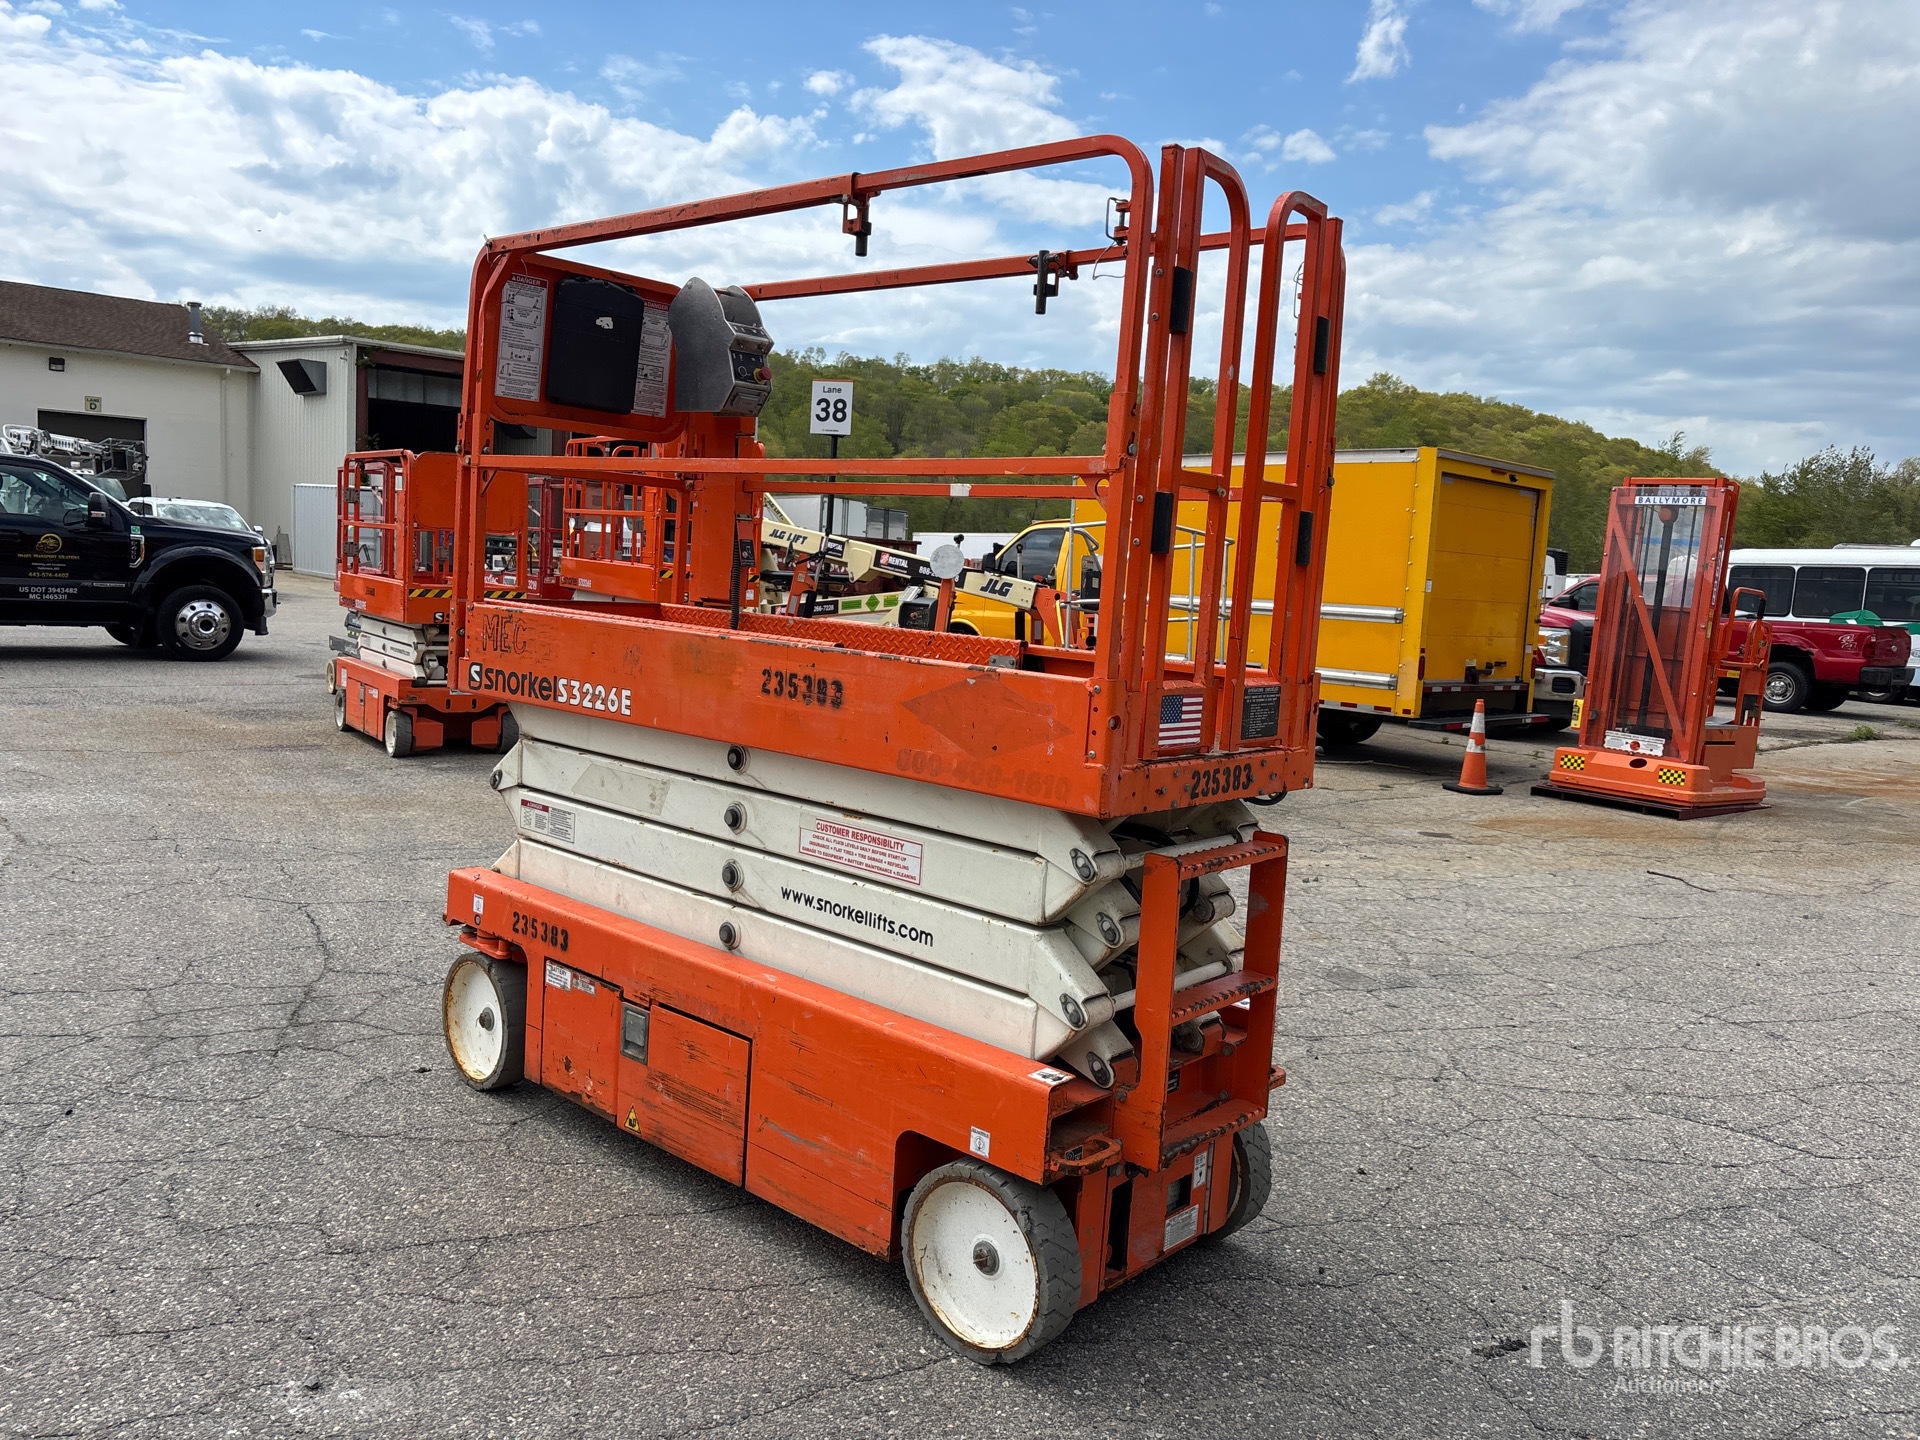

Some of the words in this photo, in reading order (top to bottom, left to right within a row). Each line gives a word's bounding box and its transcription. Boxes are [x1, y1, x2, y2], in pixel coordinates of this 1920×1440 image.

[815, 398, 847, 422] 38
[1638, 496, 1704, 505] BALLYMORE
[769, 528, 786, 540] JLG
[787, 533, 808, 545] LIFT
[888, 556, 908, 568] RENTAL
[980, 579, 1014, 597] JLG
[1190, 763, 1252, 800] 235383
[812, 833, 825, 841] CHECK
[845, 841, 859, 850] LEVELS
[859, 845, 871, 853] DAILY
[871, 848, 887, 858] BEFORE
[816, 822, 850, 838] CUSTOMER
[851, 830, 905, 852] RESPONSIBILITY
[822, 851, 844, 862] EQUIPMENT
[847, 858, 865, 867] BATTERY
[865, 862, 892, 875] MAINTENANCE
[896, 871, 917, 881] CLEANING
[857, 852, 867, 860] TIRE
[887, 860, 909, 871] REFUELING
[780, 886, 934, 948] www.snorkellifts.com
[512, 911, 569, 952] 235383
